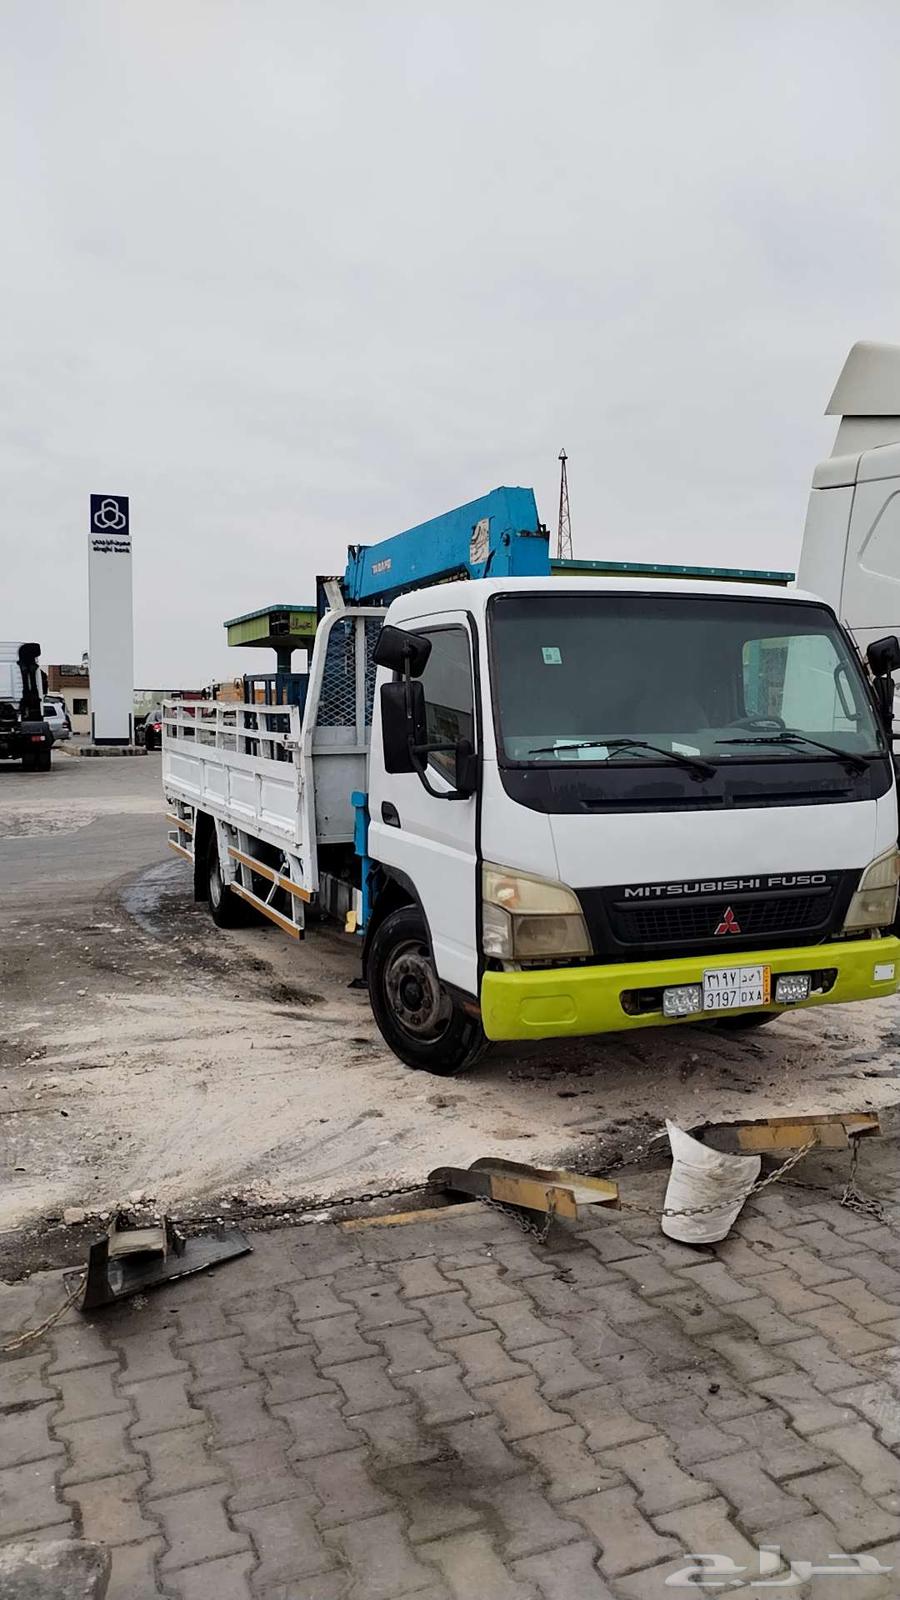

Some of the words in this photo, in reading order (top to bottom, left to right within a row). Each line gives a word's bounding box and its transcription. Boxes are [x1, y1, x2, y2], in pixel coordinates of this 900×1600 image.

[624, 879, 760, 898] MITSUBISHI
[768, 874, 826, 887] FUSO
[706, 991, 736, 1008] 3197
